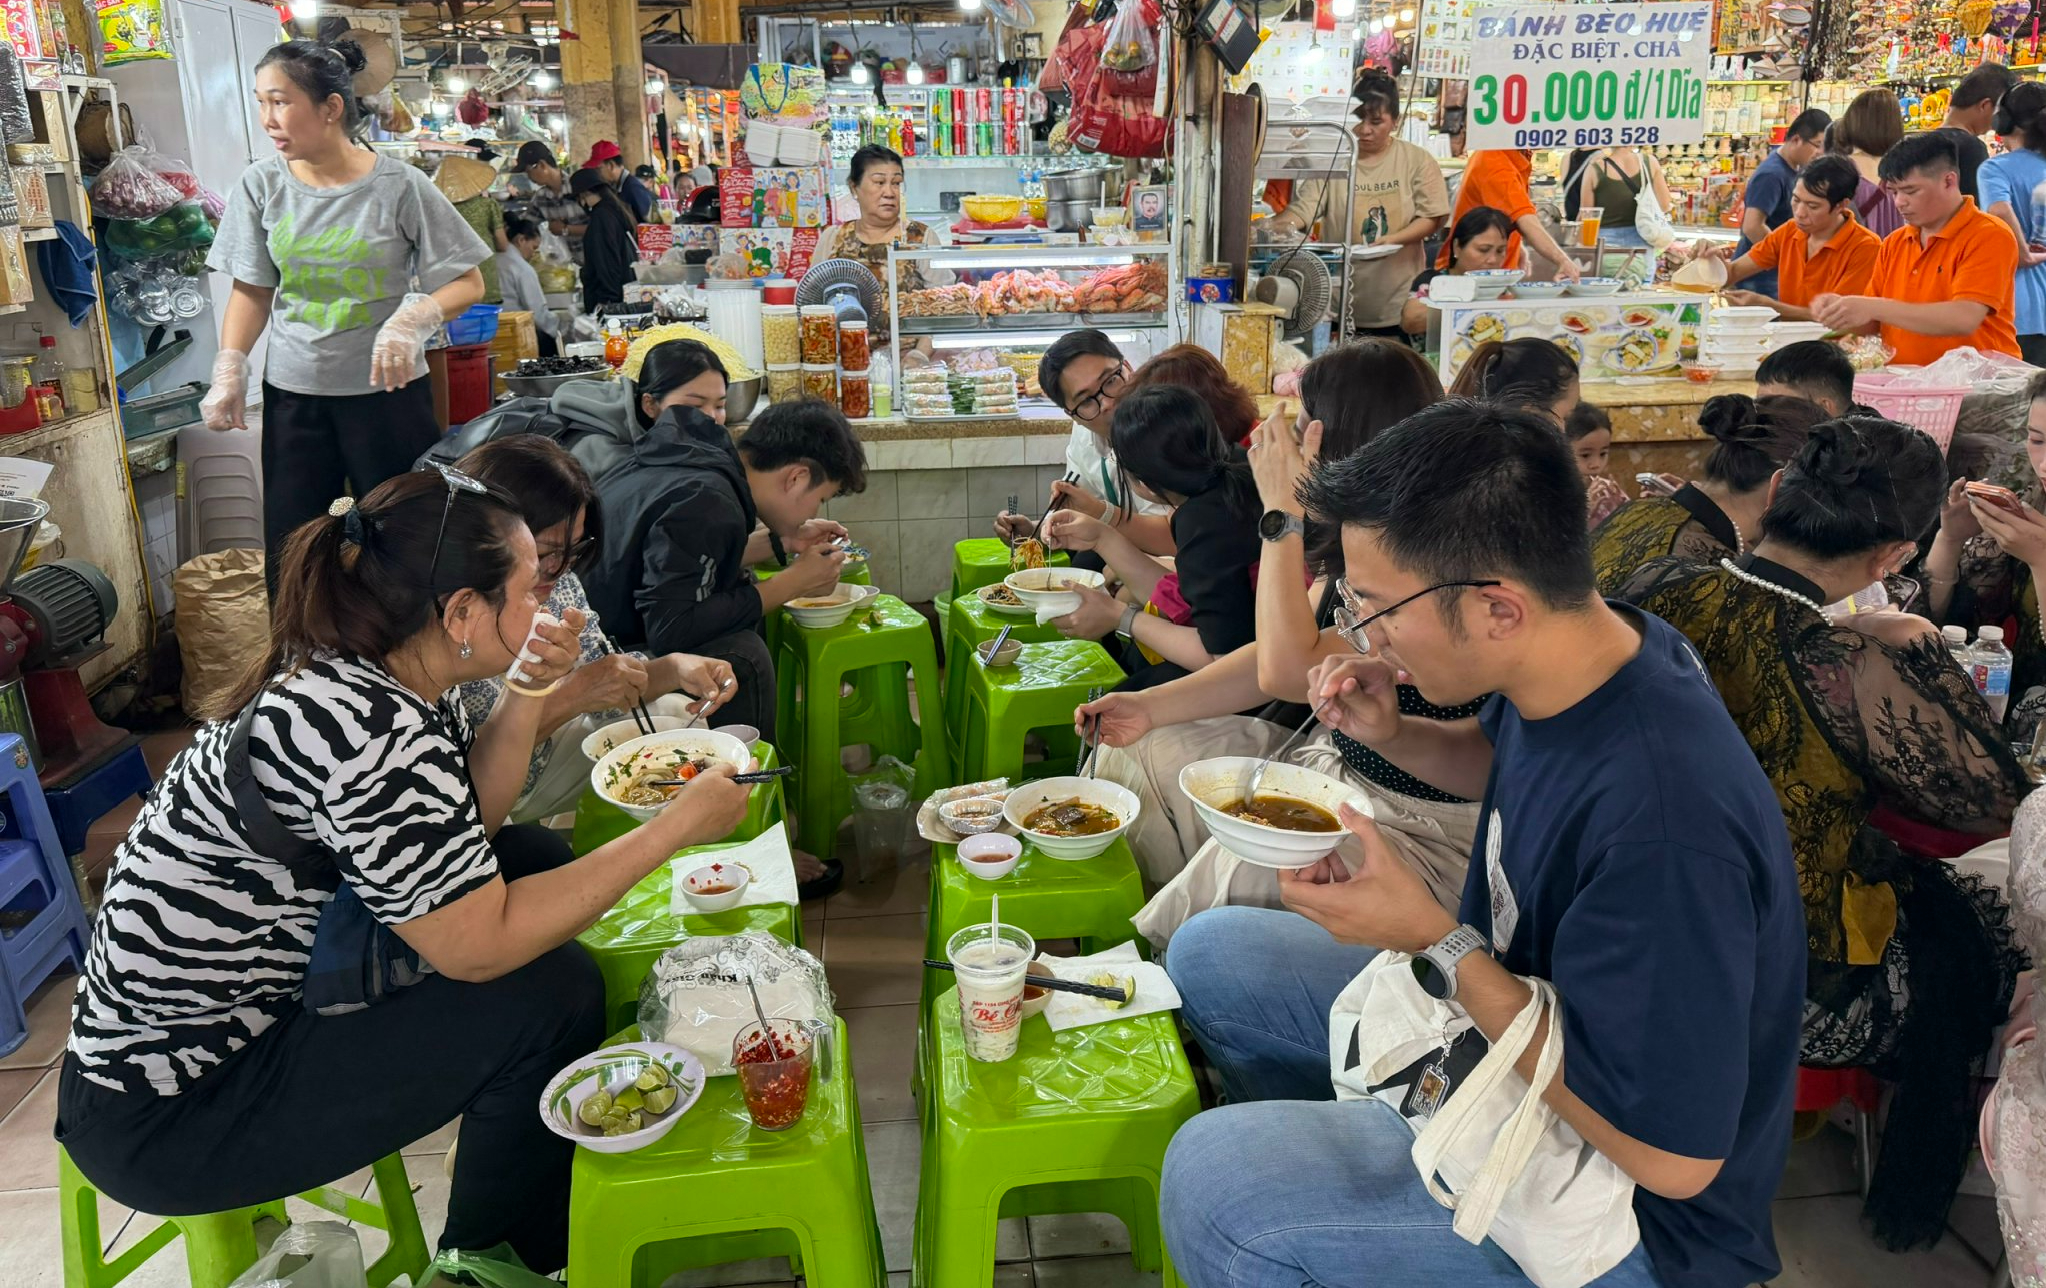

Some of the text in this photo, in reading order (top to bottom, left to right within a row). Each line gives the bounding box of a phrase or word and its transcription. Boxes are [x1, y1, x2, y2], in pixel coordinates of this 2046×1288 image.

[1478, 5, 1708, 38] BÁNH BÈO HUẾ
[1513, 39, 1563, 64] ĐẶC
[1571, 38, 1620, 63] BIỆT
[1515, 126, 1659, 146] 0902 603 528
[1374, 180, 1400, 192] BEAR
